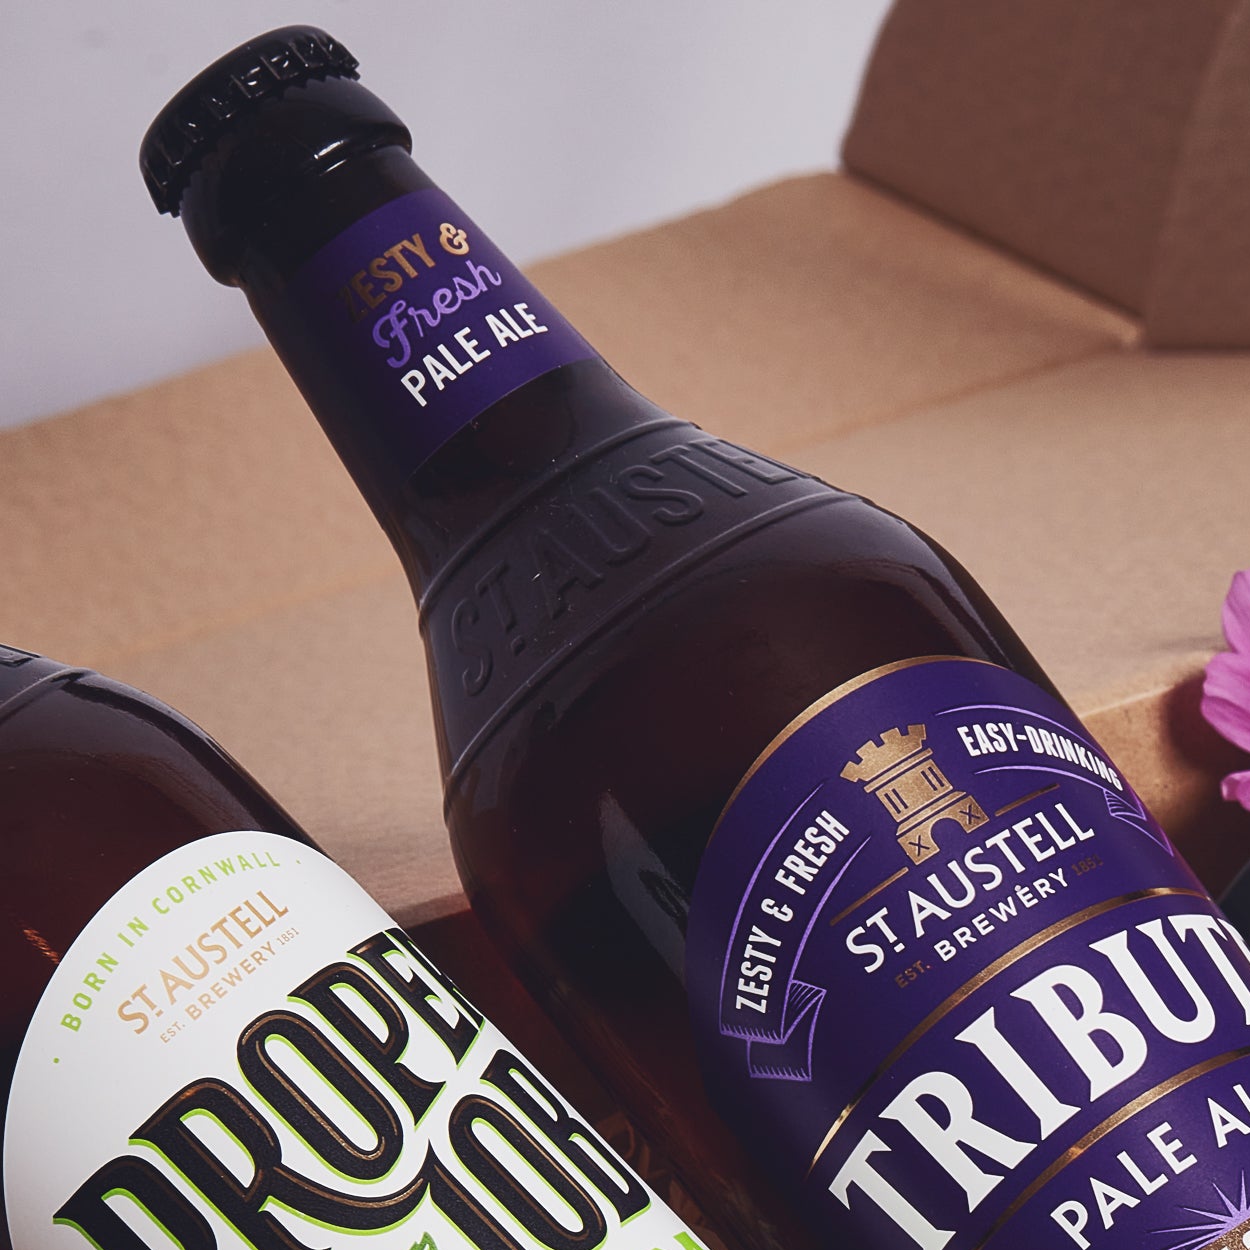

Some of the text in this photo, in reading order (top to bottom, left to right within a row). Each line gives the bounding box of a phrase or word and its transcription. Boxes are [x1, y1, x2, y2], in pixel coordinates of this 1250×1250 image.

[439, 222, 470, 256] &
[372, 260, 502, 368] Fresh
[400, 302, 548, 407] PALE ALE
[956, 723, 1124, 792] EASY-DRINKING
[735, 810, 851, 1014] ZESTY & FRESH
[895, 855, 1104, 988] EST. BREWERY 1851
[907, 802, 1095, 938] AUSTELL
[60, 851, 280, 1032] BORN IN CORNWALL
[159, 890, 288, 1006] AUSTELL
[160, 927, 300, 1044] EST. BREWERY 1851
[1049, 1121, 1198, 1250] PALE
